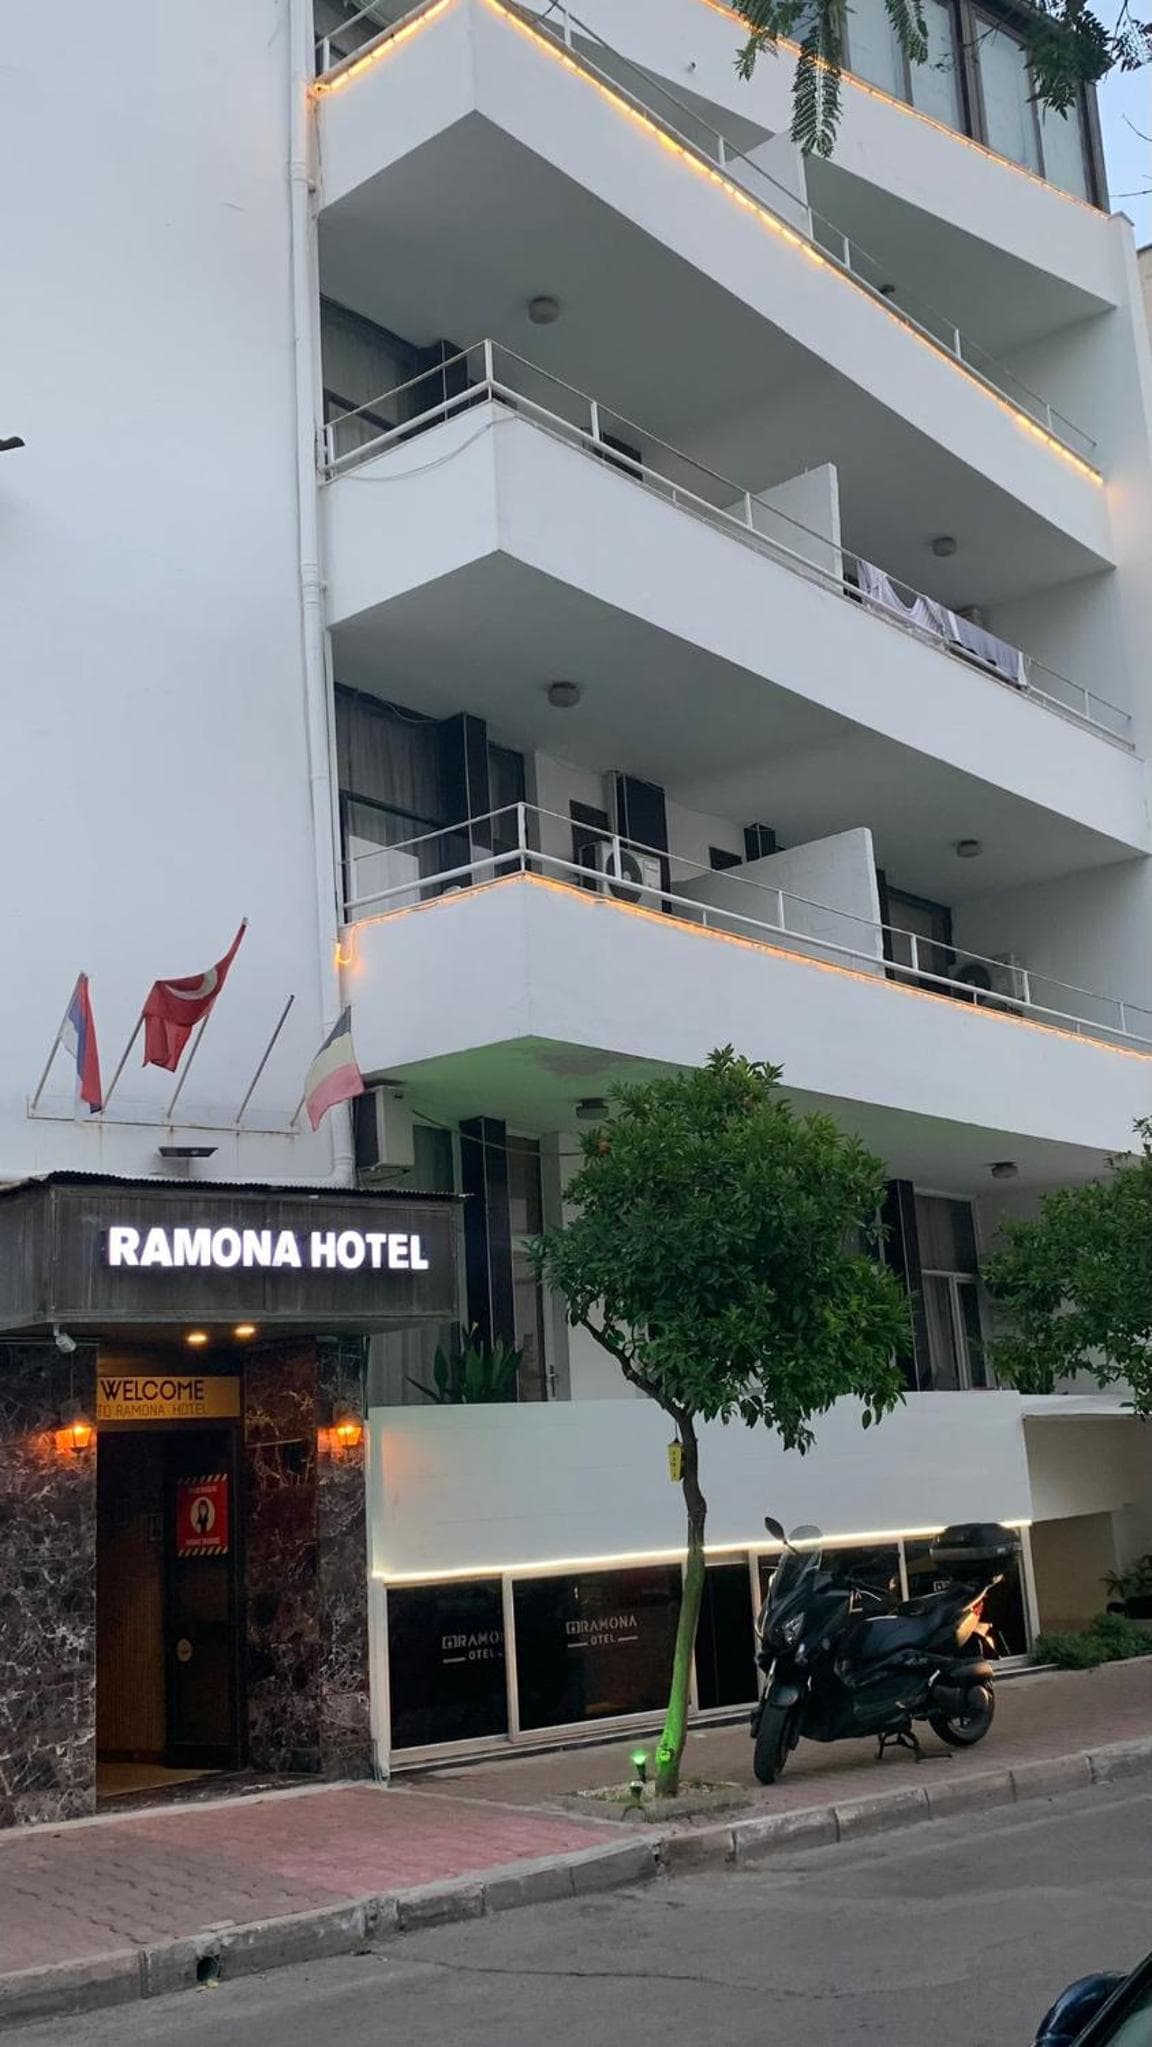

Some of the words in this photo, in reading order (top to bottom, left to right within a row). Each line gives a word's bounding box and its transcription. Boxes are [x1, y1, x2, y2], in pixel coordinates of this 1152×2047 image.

[109, 1227, 301, 1267] RAMONA
[311, 1231, 429, 1270] HOTEL
[100, 1380, 205, 1401] WELCOME
[98, 1403, 111, 1417] TO
[116, 1402, 165, 1416] RAMONA
[172, 1401, 208, 1415] HOTEL
[581, 1615, 638, 1633] RAMONA
[458, 1631, 502, 1648] RAMO
[590, 1633, 616, 1646] OTEL
[468, 1648, 495, 1660] OTEL
